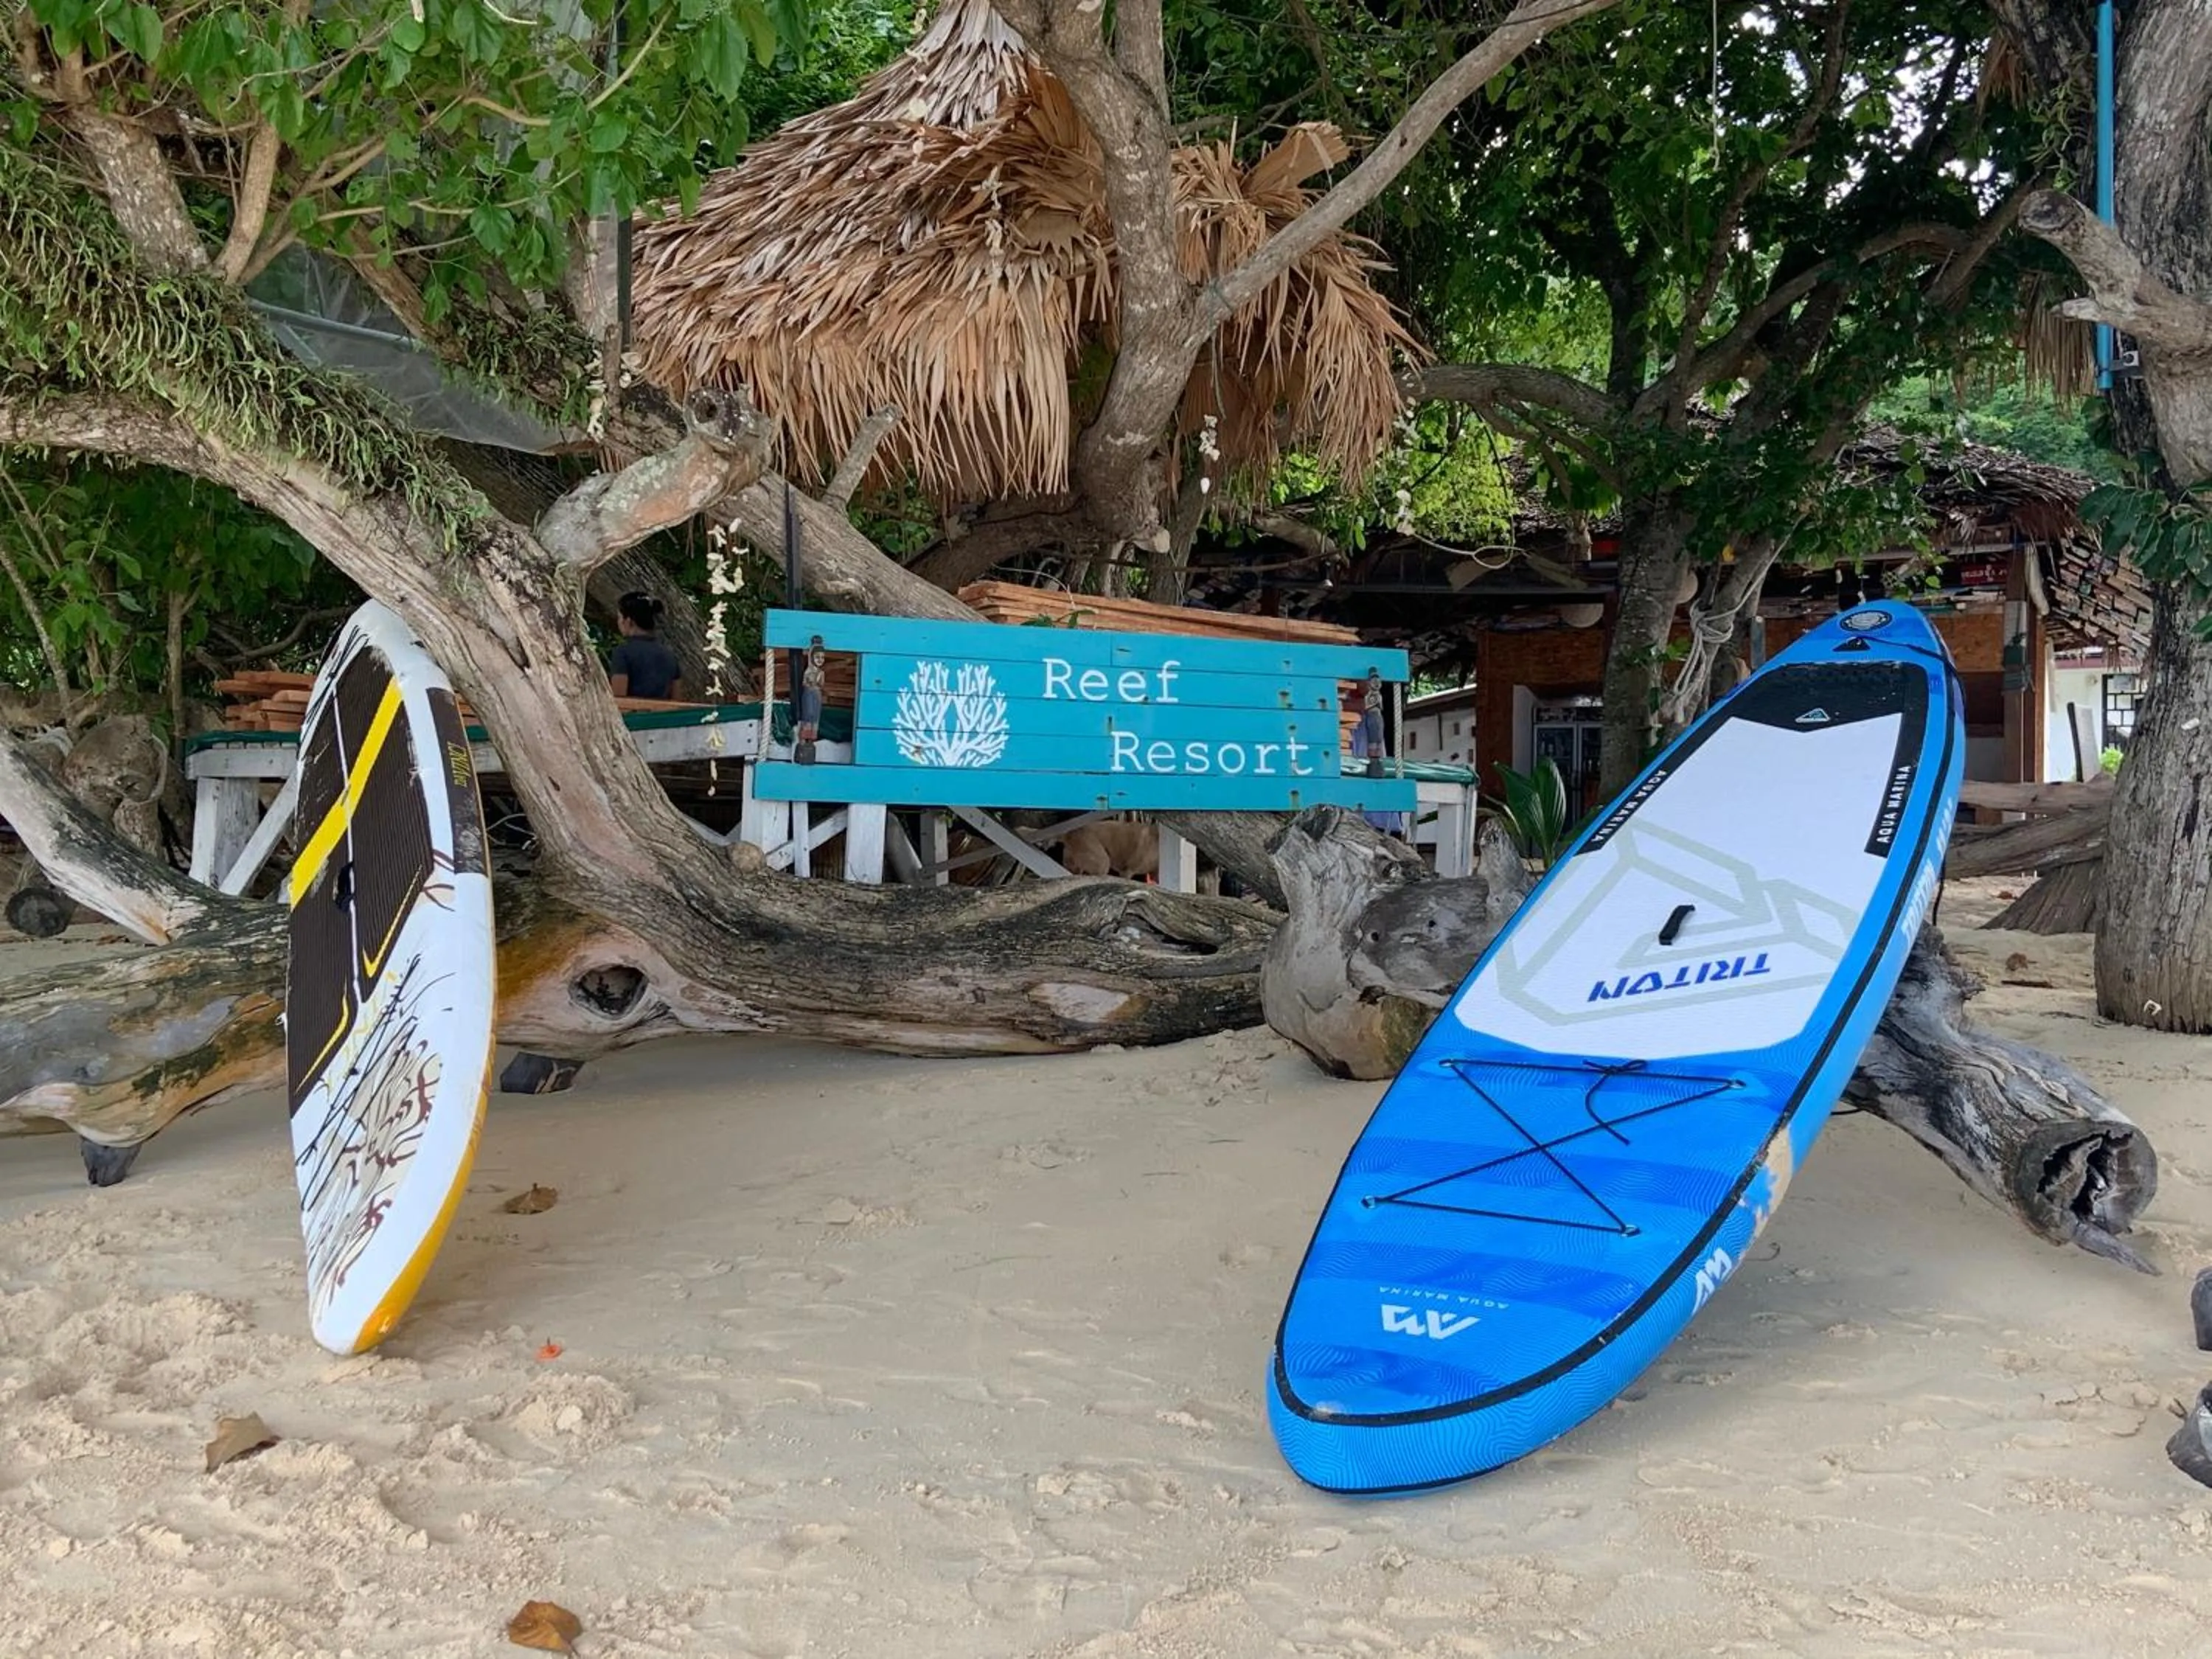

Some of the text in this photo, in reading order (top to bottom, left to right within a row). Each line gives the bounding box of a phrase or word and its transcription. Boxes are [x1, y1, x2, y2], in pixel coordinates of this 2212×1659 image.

[1042, 657, 1180, 703] Reef
[1110, 730, 1314, 775] Resort
[1875, 765, 1912, 844] AQUA MARINA
[1587, 952, 1771, 1003] TRITON
[1379, 1286, 1510, 1310] AQUA MARINA
